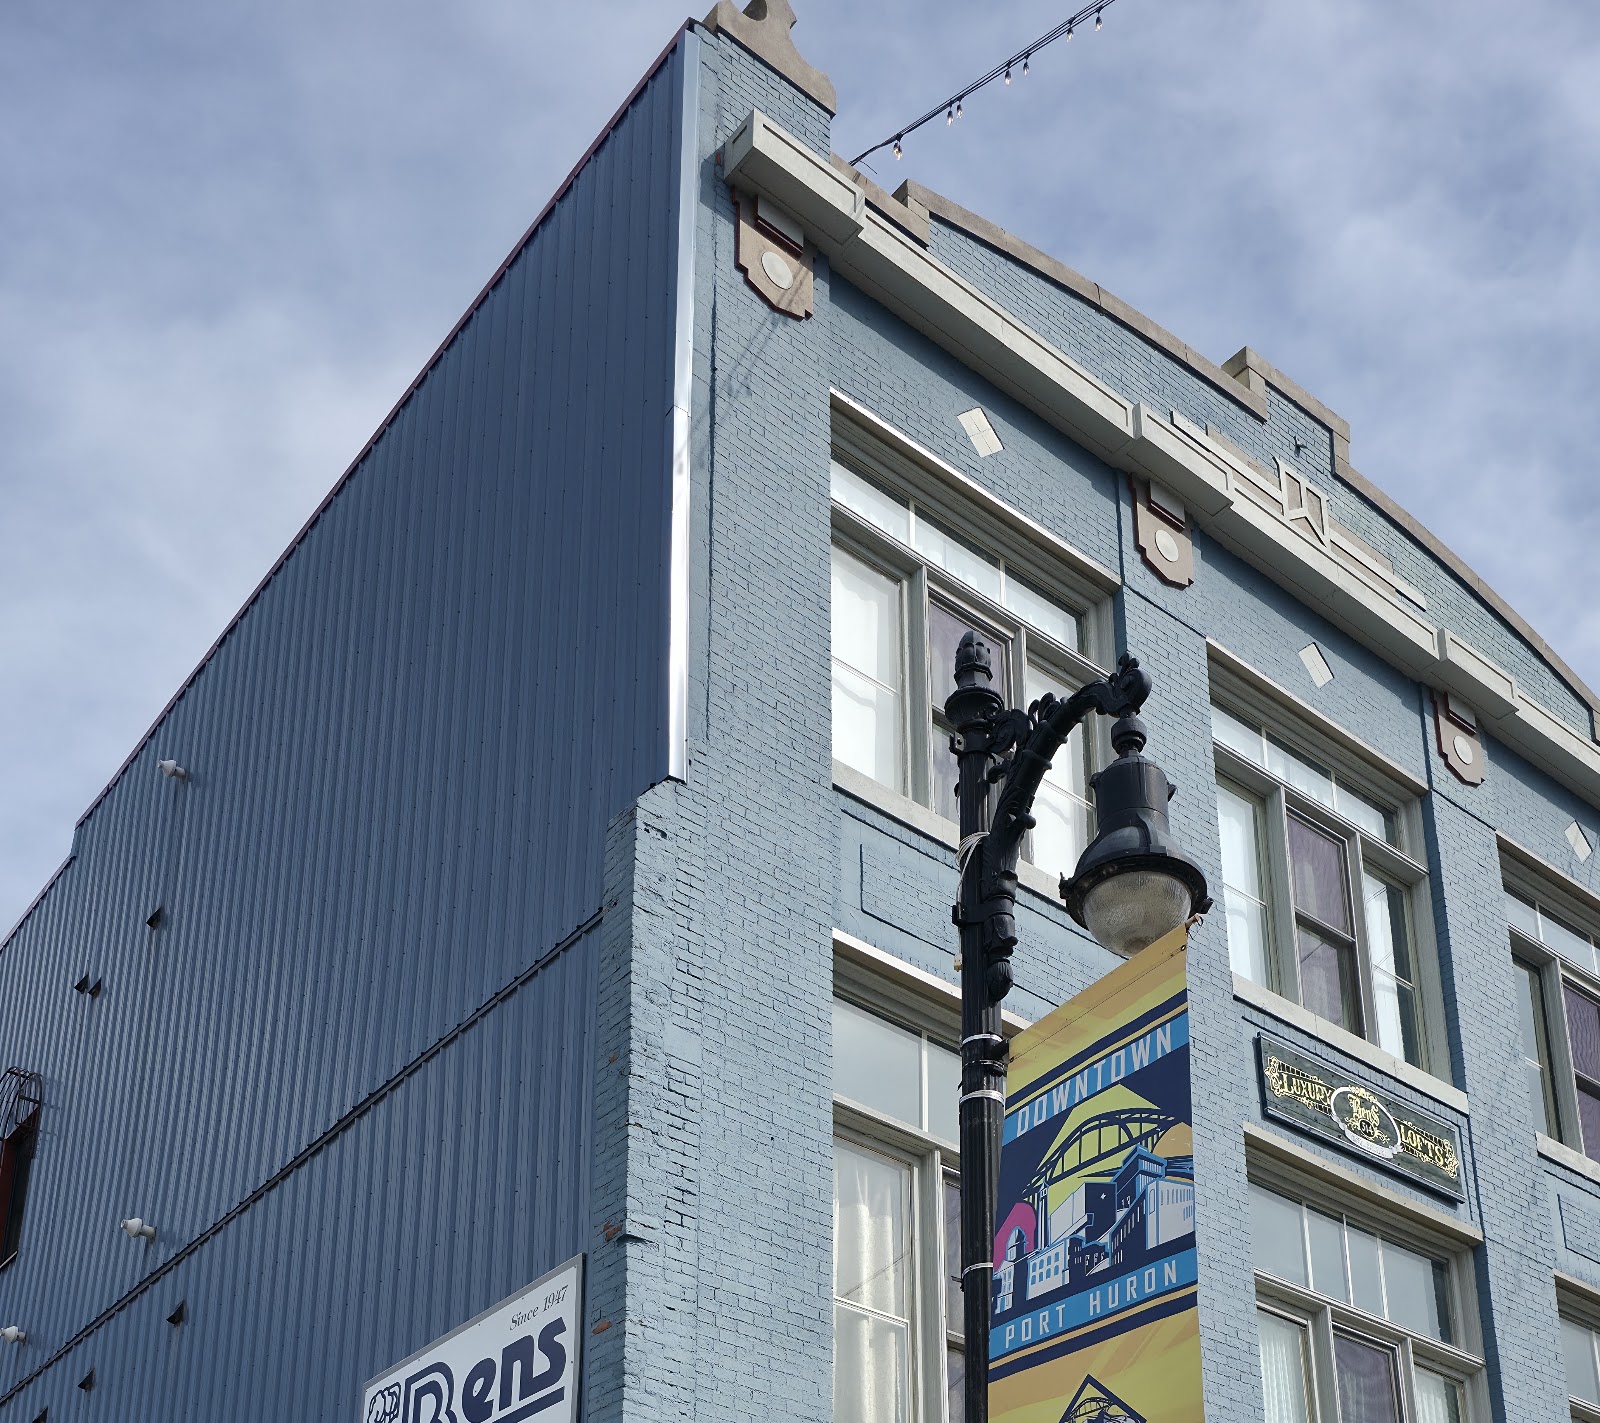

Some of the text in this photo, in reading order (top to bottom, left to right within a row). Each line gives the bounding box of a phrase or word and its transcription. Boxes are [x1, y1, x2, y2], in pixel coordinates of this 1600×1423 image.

[1016, 1022, 1172, 1138] DOWNTOWN
[1279, 1072, 1332, 1105] LUXURY
[1400, 1124, 1444, 1166] LOFTS
[509, 1284, 569, 1331] Since 1947
[1005, 1259, 1178, 1349] PORT HURON
